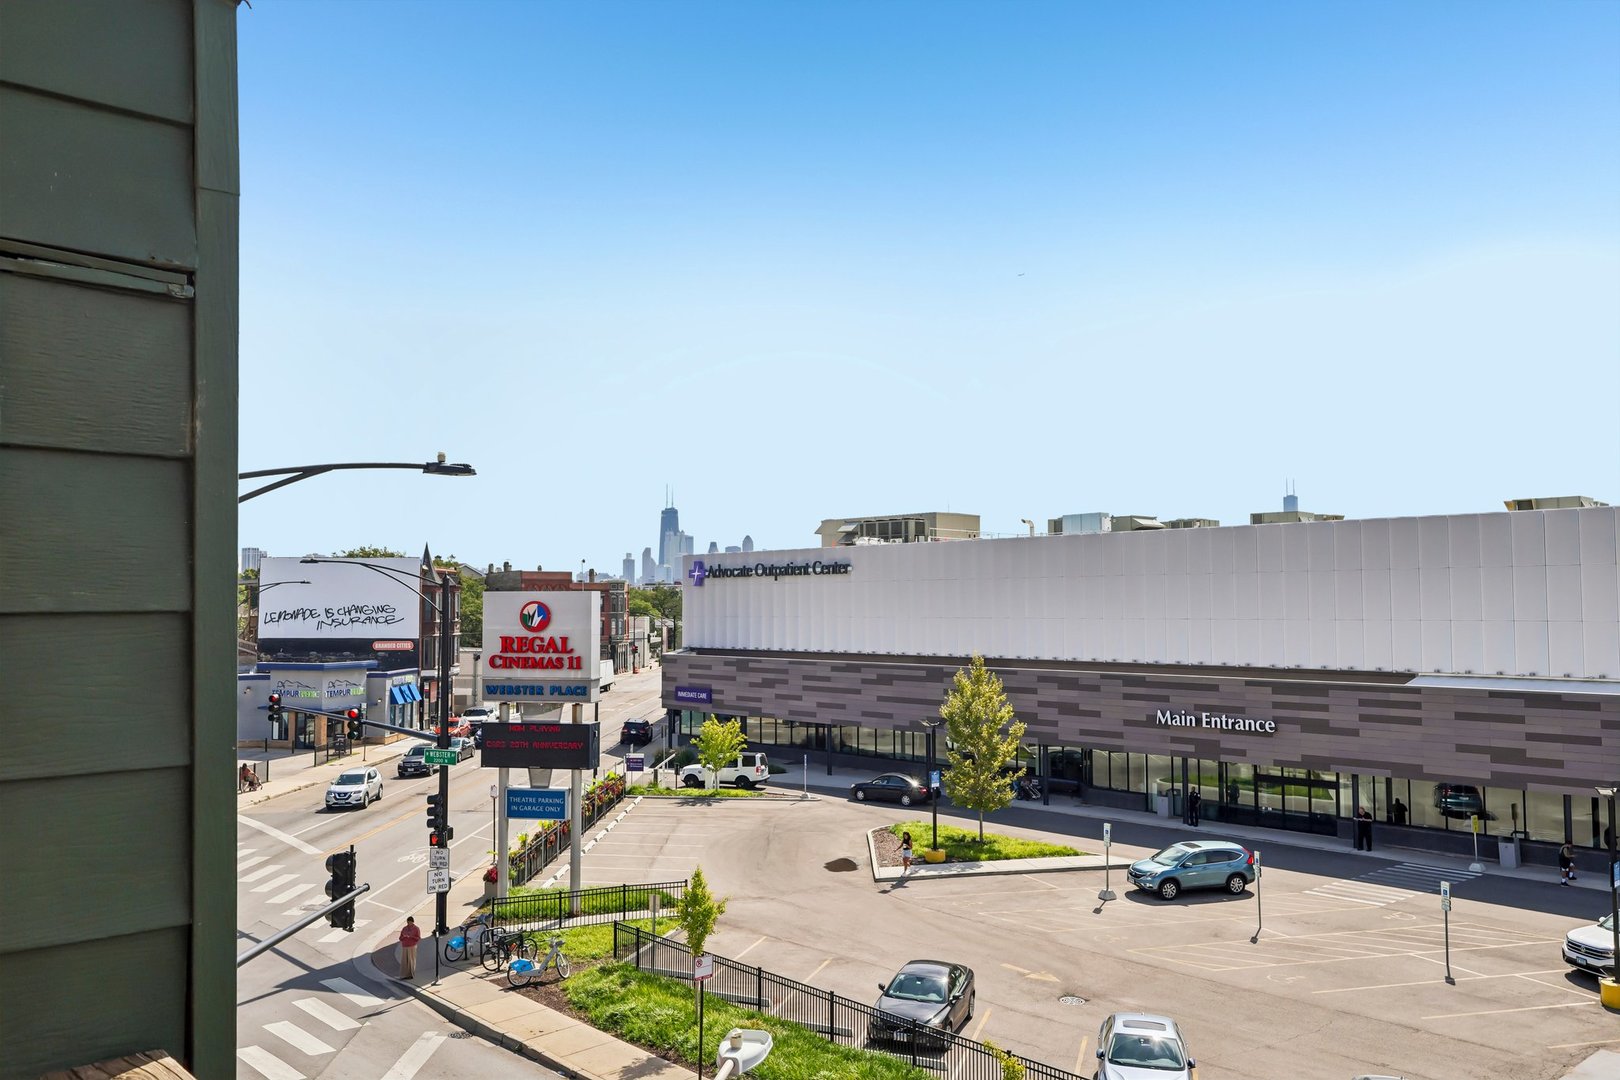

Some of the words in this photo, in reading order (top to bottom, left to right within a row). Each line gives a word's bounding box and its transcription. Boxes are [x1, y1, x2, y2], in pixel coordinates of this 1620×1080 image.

[707, 564, 752, 578] Advocate
[754, 562, 811, 581] Outpatient
[812, 560, 850, 575] Center
[264, 608, 320, 624] LEMONADE
[325, 608, 334, 619] IS
[337, 604, 396, 616] CHANGING
[317, 615, 404, 631] INSURANCE
[499, 636, 574, 654] REGAL
[488, 655, 564, 670] CINEMAS
[567, 656, 582, 670] 11
[486, 684, 544, 696] WEBSTER
[550, 685, 588, 696] PLACE
[1156, 710, 1196, 727] Main
[1201, 712, 1276, 732] Entrance
[532, 741, 584, 750] ANNIVERSARY
